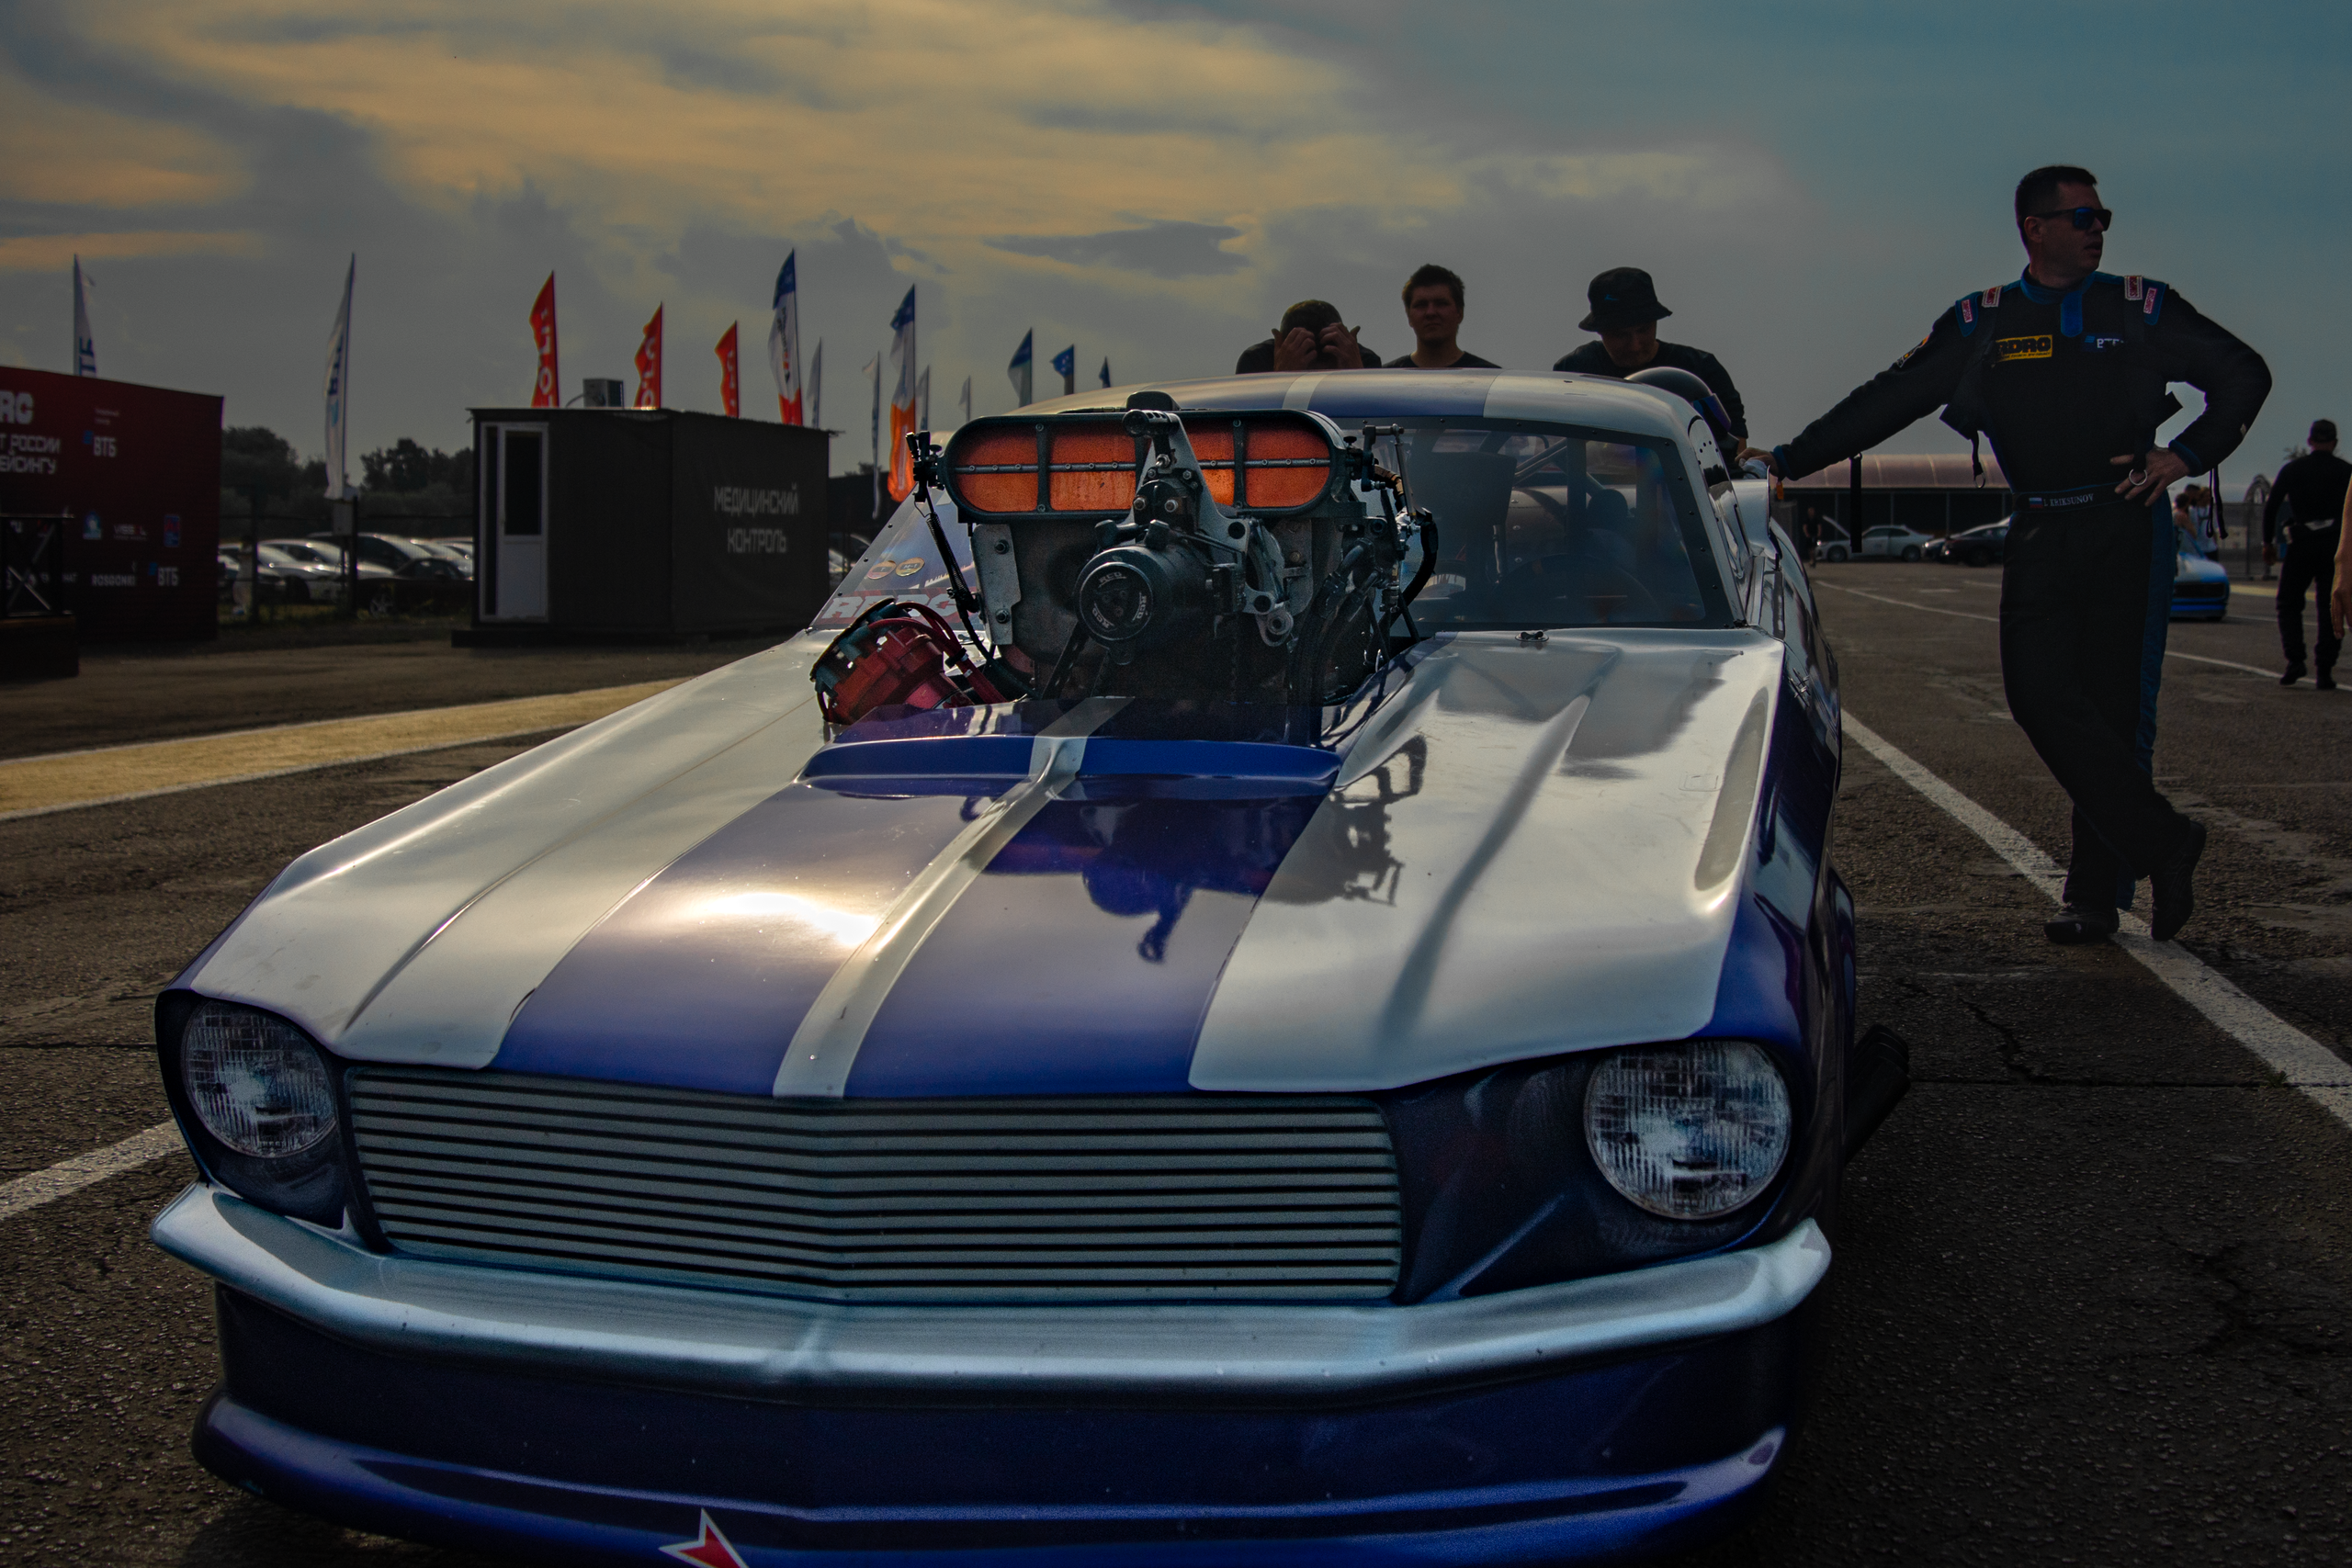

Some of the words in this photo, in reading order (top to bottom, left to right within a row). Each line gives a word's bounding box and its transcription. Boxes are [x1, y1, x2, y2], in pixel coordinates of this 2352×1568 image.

[10, 434, 62, 454] РОССИИ
[94, 436, 118, 457] ВТБ
[714, 482, 799, 518] МЕДИЦИНСКИЙ
[2050, 493, 2094, 506] KRIKSUNOV
[727, 527, 787, 554] КОНТРОЛЬ
[157, 567, 180, 586] ВТБ
